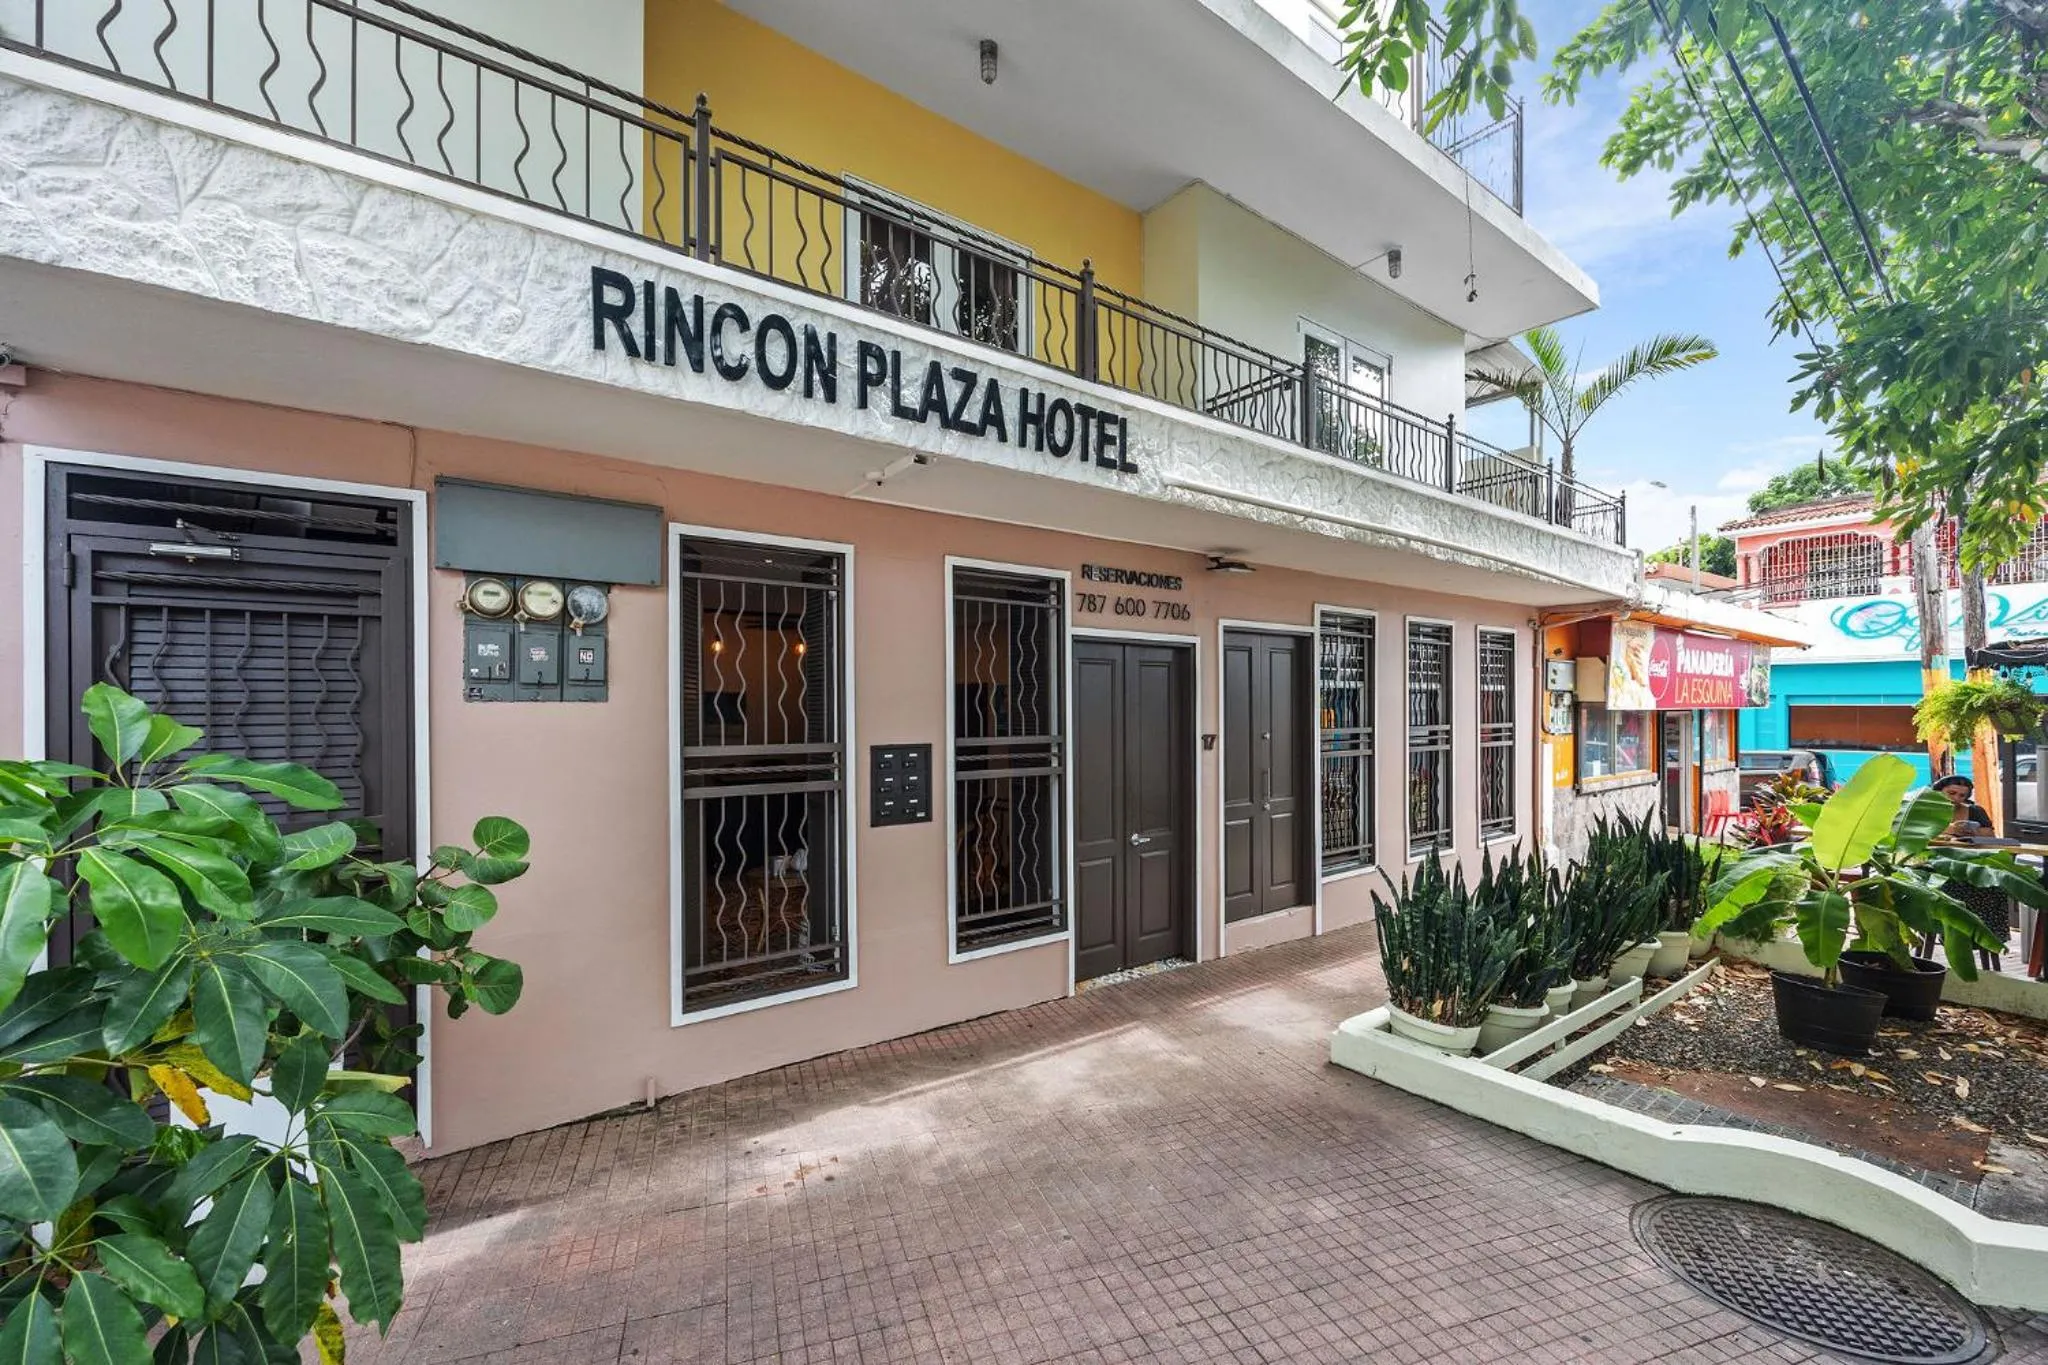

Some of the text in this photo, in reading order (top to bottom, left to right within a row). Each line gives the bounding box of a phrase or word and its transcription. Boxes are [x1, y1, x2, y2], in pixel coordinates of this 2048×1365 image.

[591, 265, 1138, 473] RINCON PLAZA HOTEL
[1081, 564, 1183, 591] RESERVACIONES
[1075, 593, 1191, 621] 787 600 7706
[1676, 647, 1734, 677] PANADERÍA
[1674, 677, 1734, 705] LA ESQUINA
[1201, 734, 1218, 751] 17
